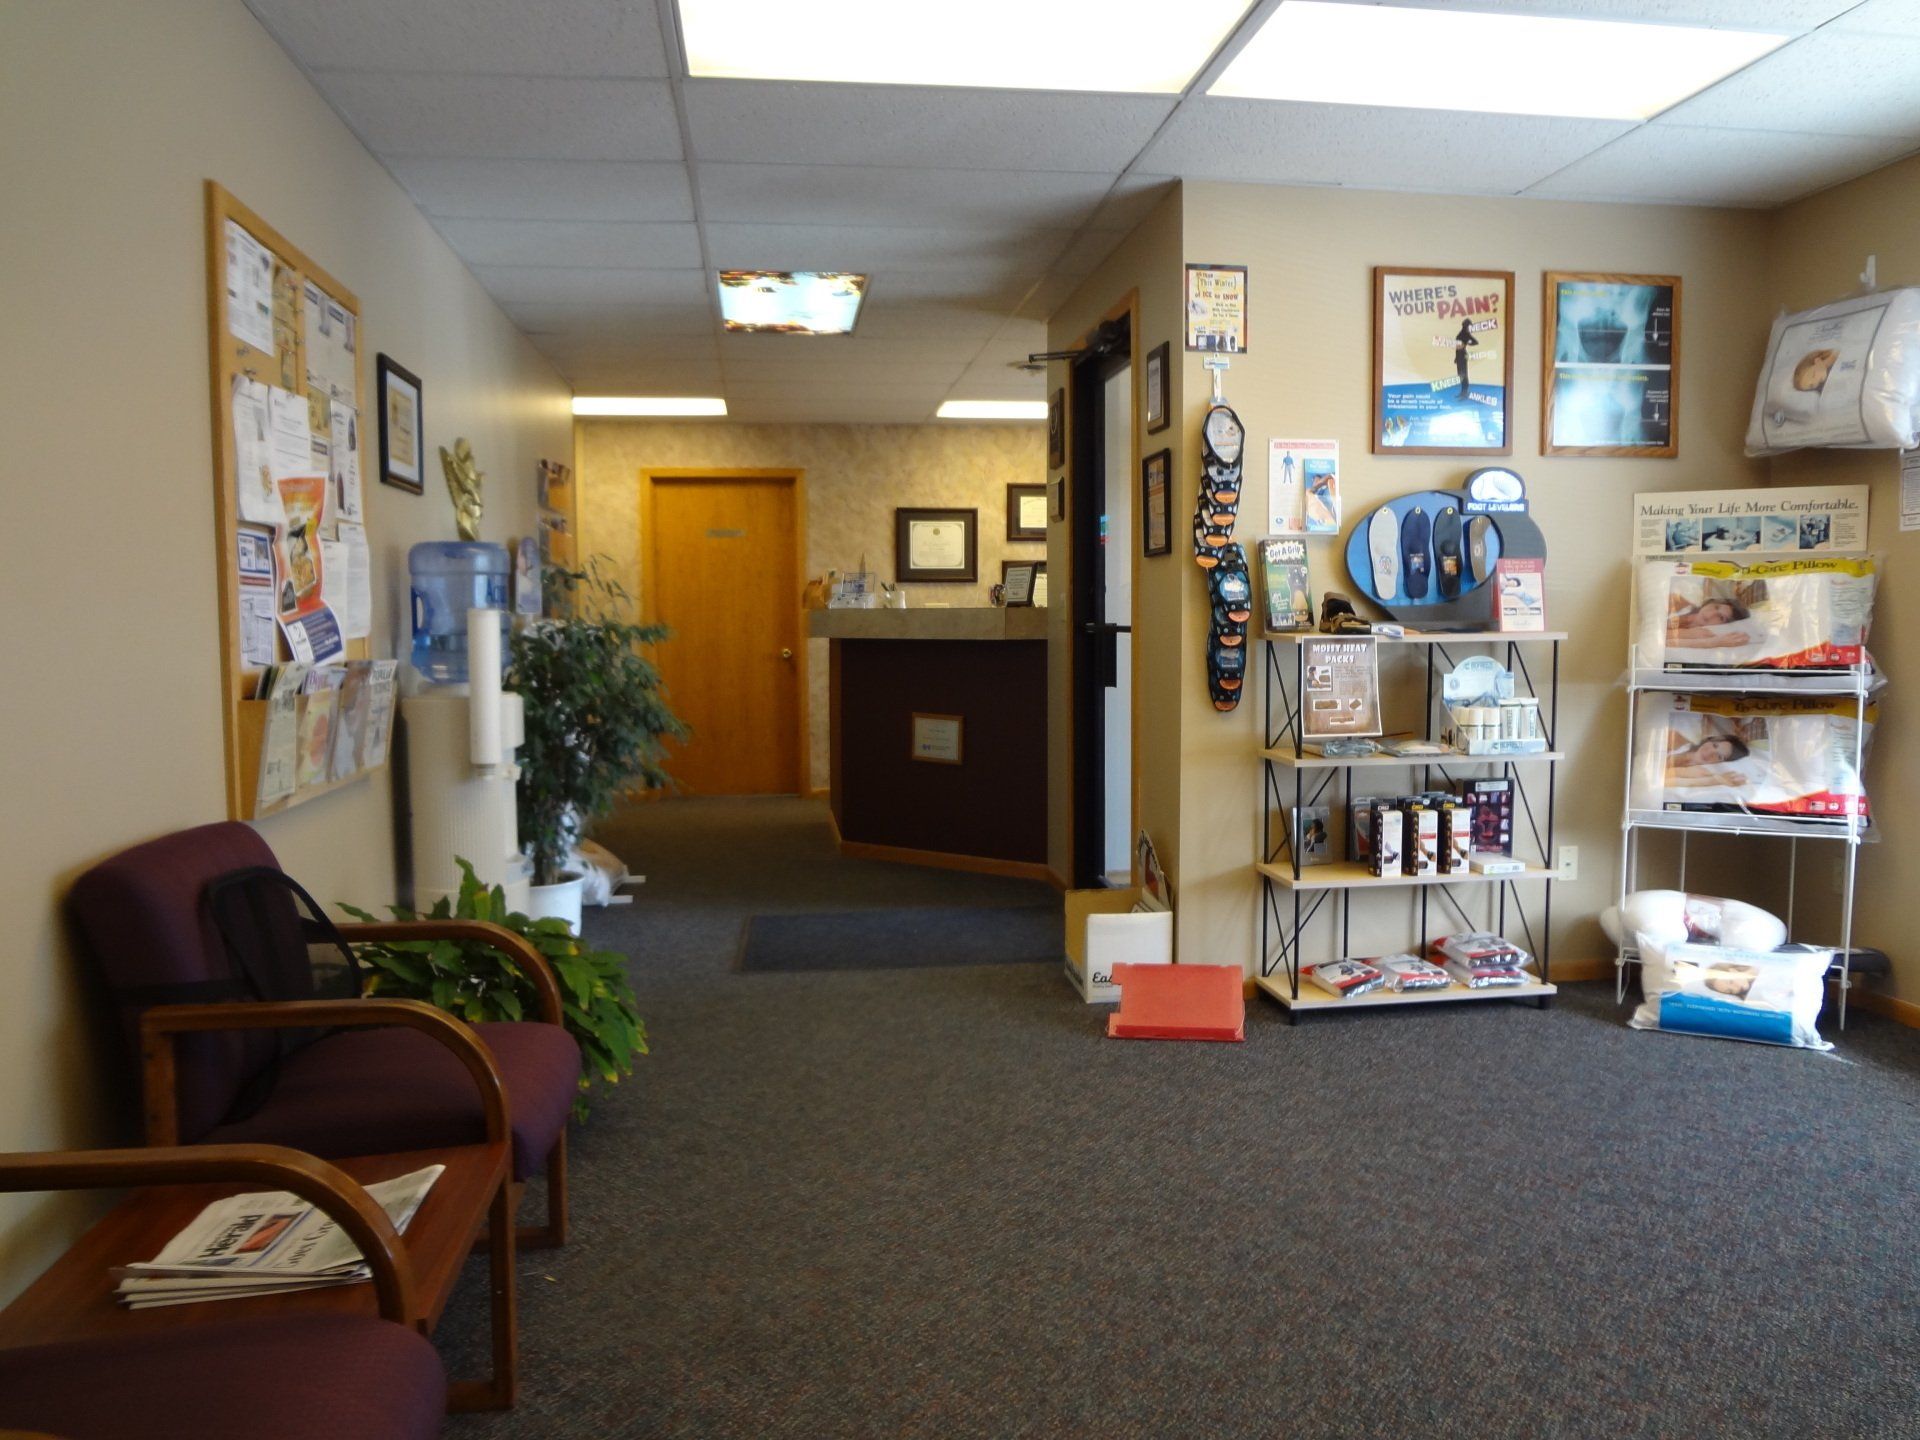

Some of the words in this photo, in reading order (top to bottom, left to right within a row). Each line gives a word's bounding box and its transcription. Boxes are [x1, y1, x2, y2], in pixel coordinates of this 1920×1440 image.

[1389, 286, 1457, 304] WHERE'S
[1394, 303, 1435, 317] YOUR
[1437, 293, 1499, 320] PAIN?
[1468, 319, 1497, 333] NECK
[1469, 392, 1498, 406] ANKLES
[1467, 503, 1486, 512] FOOT
[1641, 503, 1684, 517] Making
[1688, 502, 1714, 514] Your
[1718, 501, 1741, 514] Life
[1745, 500, 1776, 512] More
[1780, 498, 1858, 513] Comfortable.
[1791, 560, 1838, 571] Pillow
[1343, 643, 1367, 653] HEAT
[1325, 655, 1356, 664] PACKS
[198, 1213, 266, 1258] Herald
